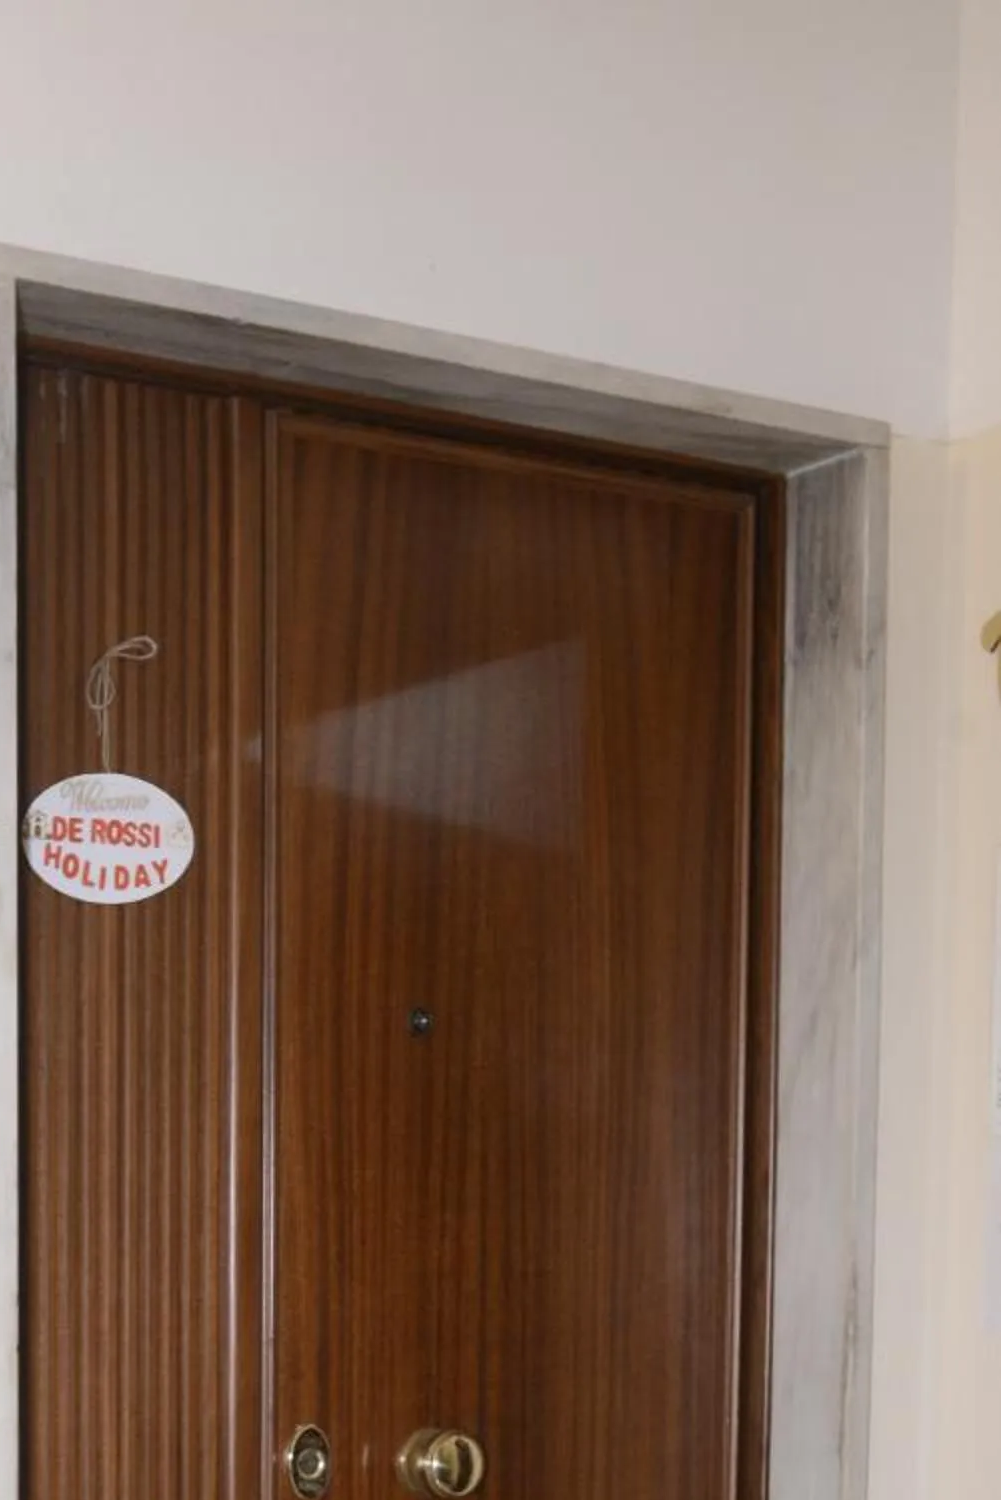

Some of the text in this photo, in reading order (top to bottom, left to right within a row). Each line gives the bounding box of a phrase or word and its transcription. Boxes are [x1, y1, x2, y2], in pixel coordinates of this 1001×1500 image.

[52, 815, 161, 849] DE ROSSI
[43, 843, 169, 891] HOLIDAY
